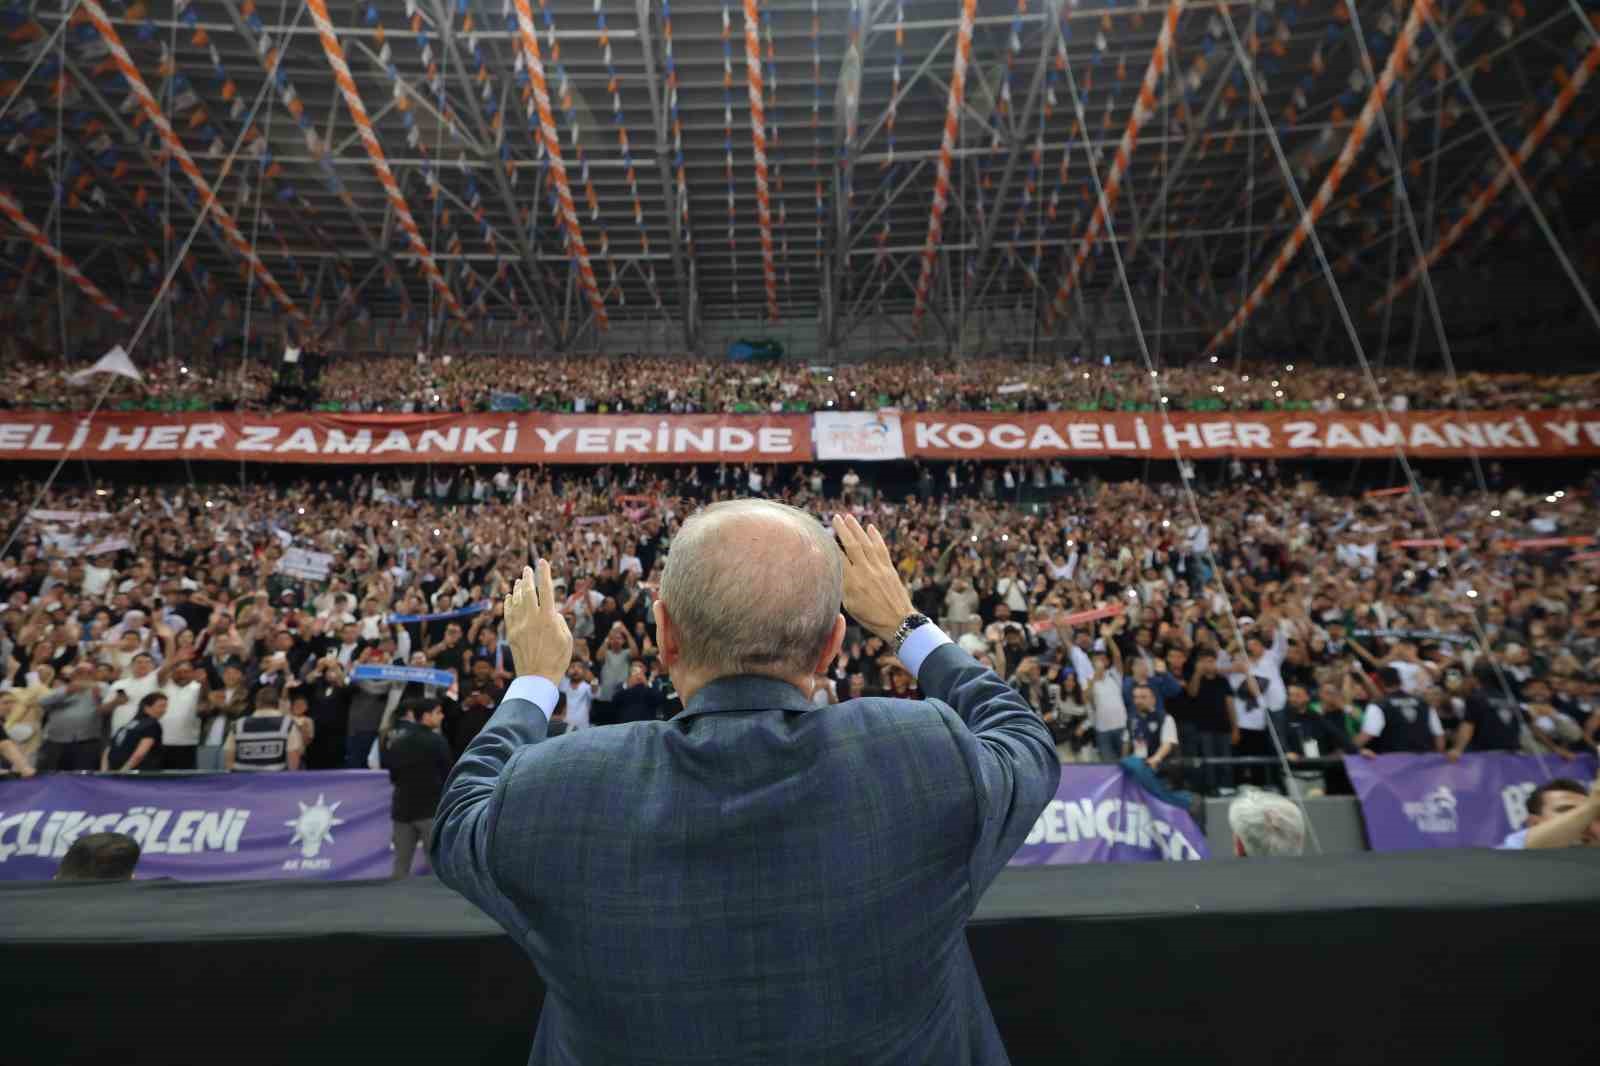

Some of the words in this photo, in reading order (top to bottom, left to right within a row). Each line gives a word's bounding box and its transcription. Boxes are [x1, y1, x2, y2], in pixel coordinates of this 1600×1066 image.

[97, 422, 227, 451] HER
[235, 420, 518, 453] ZAMANKİ
[535, 420, 793, 453] YERİNDE
[914, 416, 1153, 450] KOCAELİ
[1162, 420, 1272, 449] HER
[1282, 415, 1540, 449] ZAMANKİ
